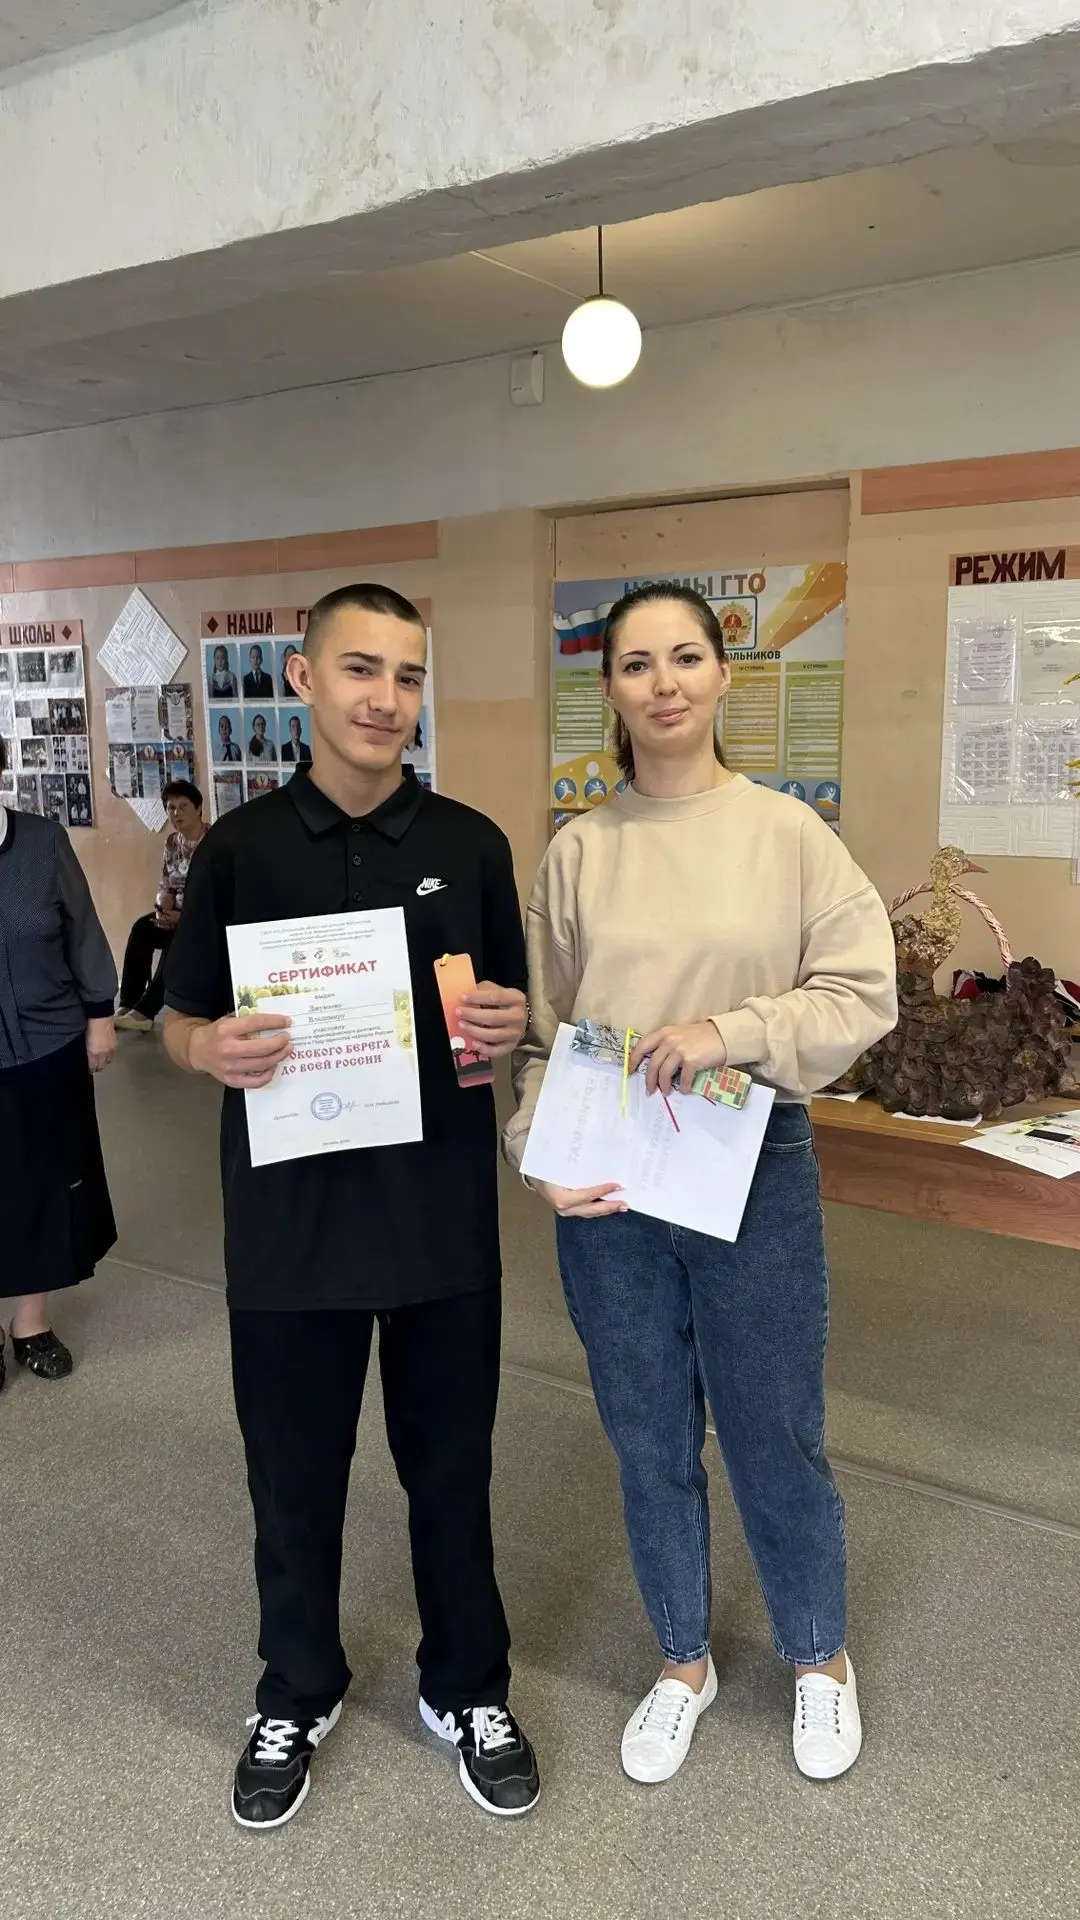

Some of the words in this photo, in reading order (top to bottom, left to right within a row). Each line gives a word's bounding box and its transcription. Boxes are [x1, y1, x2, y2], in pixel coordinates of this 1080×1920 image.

[956, 549, 1066, 586] РЕЖИМ
[624, 576, 713, 597] НМЫ
[721, 572, 767, 598] ГТО
[9, 624, 55, 645] ШКОЛЫ
[227, 612, 274, 635] НАША
[421, 877, 442, 889] NIKE
[268, 960, 377, 984] СЕРТИФИКАТ
[289, 1046, 343, 1061] ОКСКОГО
[345, 1039, 391, 1054] БЕРЕГА
[281, 1064, 297, 1076] ДО
[300, 1060, 331, 1073] ВСЕЙ
[335, 1054, 382, 1068] РОССИИ
